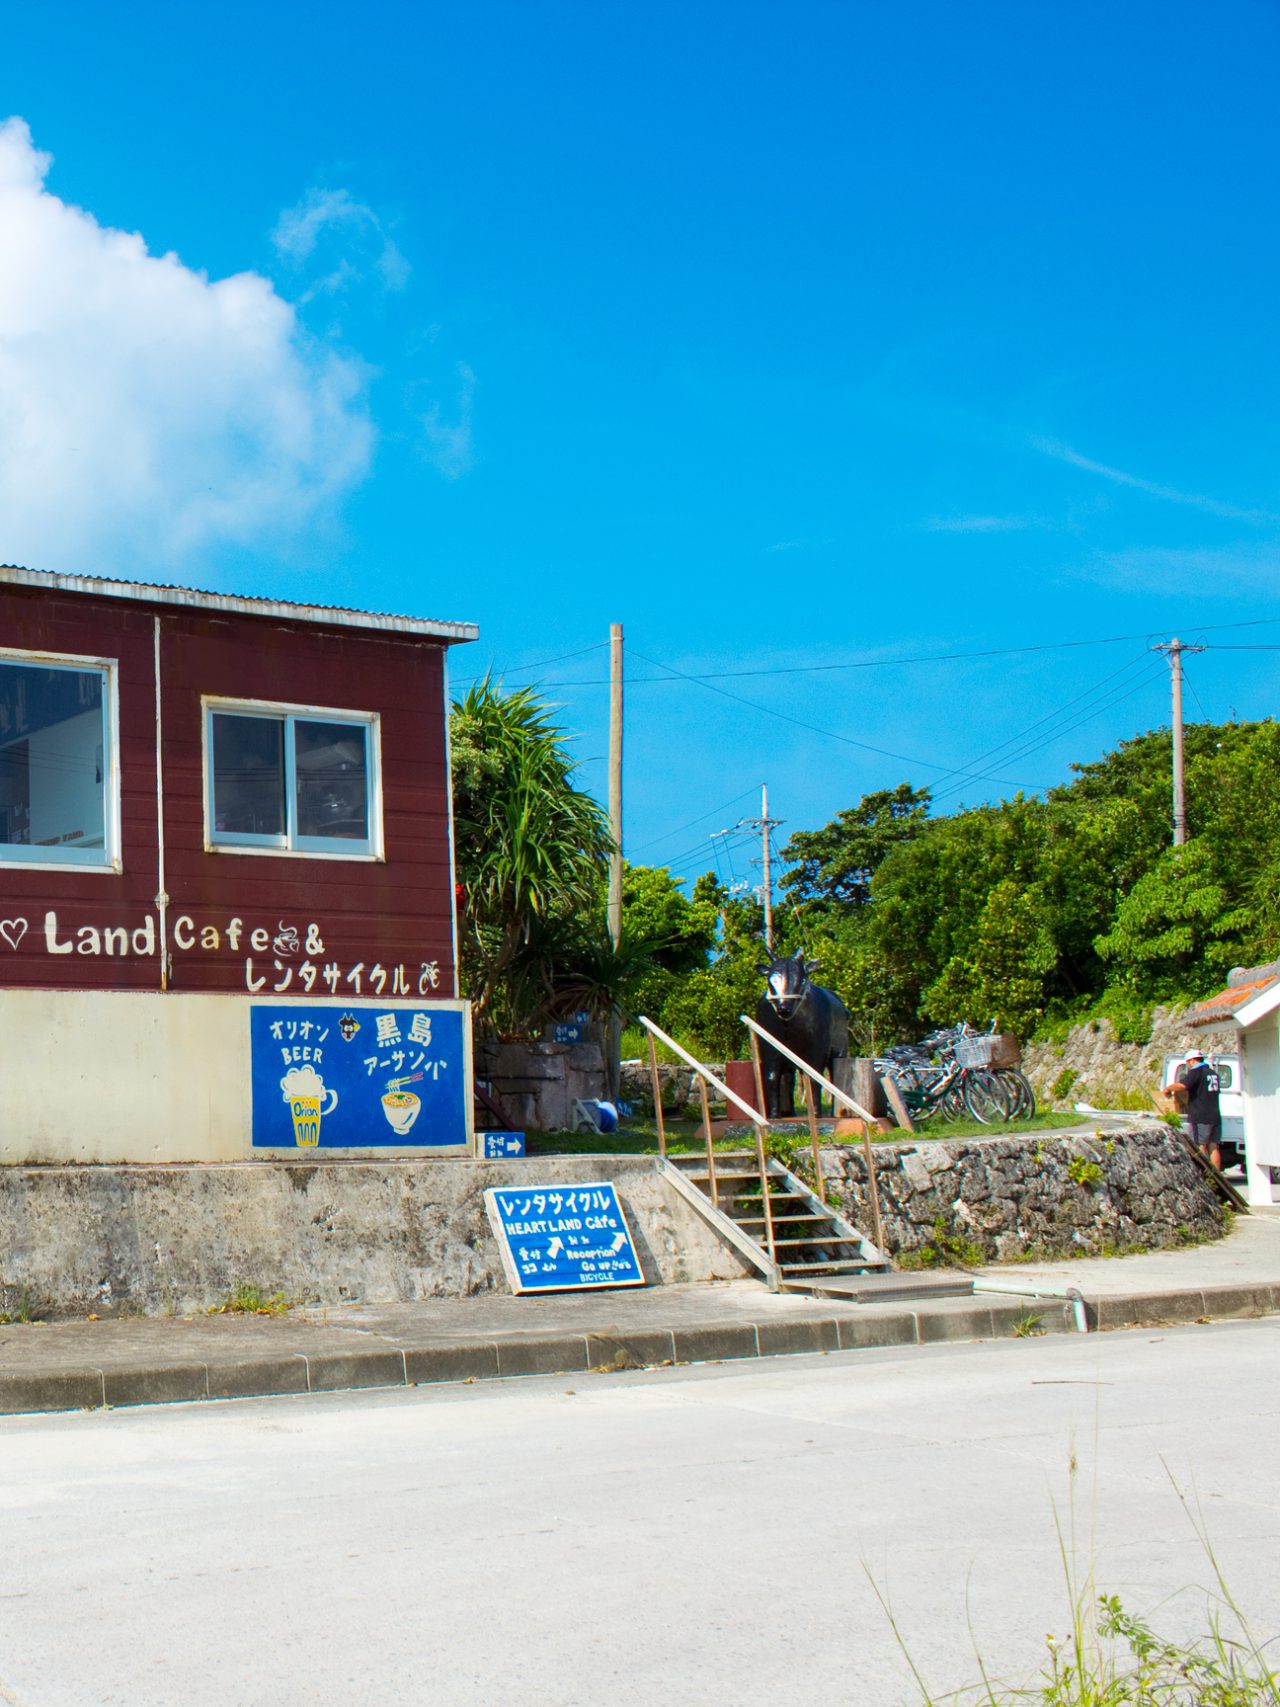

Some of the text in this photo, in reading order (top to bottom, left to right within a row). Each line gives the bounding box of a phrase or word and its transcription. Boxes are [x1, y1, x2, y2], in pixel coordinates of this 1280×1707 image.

[45, 911, 154, 955] Land
[174, 915, 268, 951] Cafe
[305, 923, 325, 955] &
[246, 957, 410, 995] レンタサイクル
[270, 1021, 330, 1042] オリオン
[375, 1013, 432, 1047] 黒島
[281, 1048, 323, 1065] BEER
[294, 1102, 319, 1117] Orion
[499, 1191, 610, 1216] レンタサイクル
[505, 1221, 547, 1235] HEART
[548, 1219, 582, 1232] LAND
[566, 1246, 616, 1260] Reception
[581, 1261, 596, 1272] Go
[579, 1272, 615, 1283] BICYCLE
